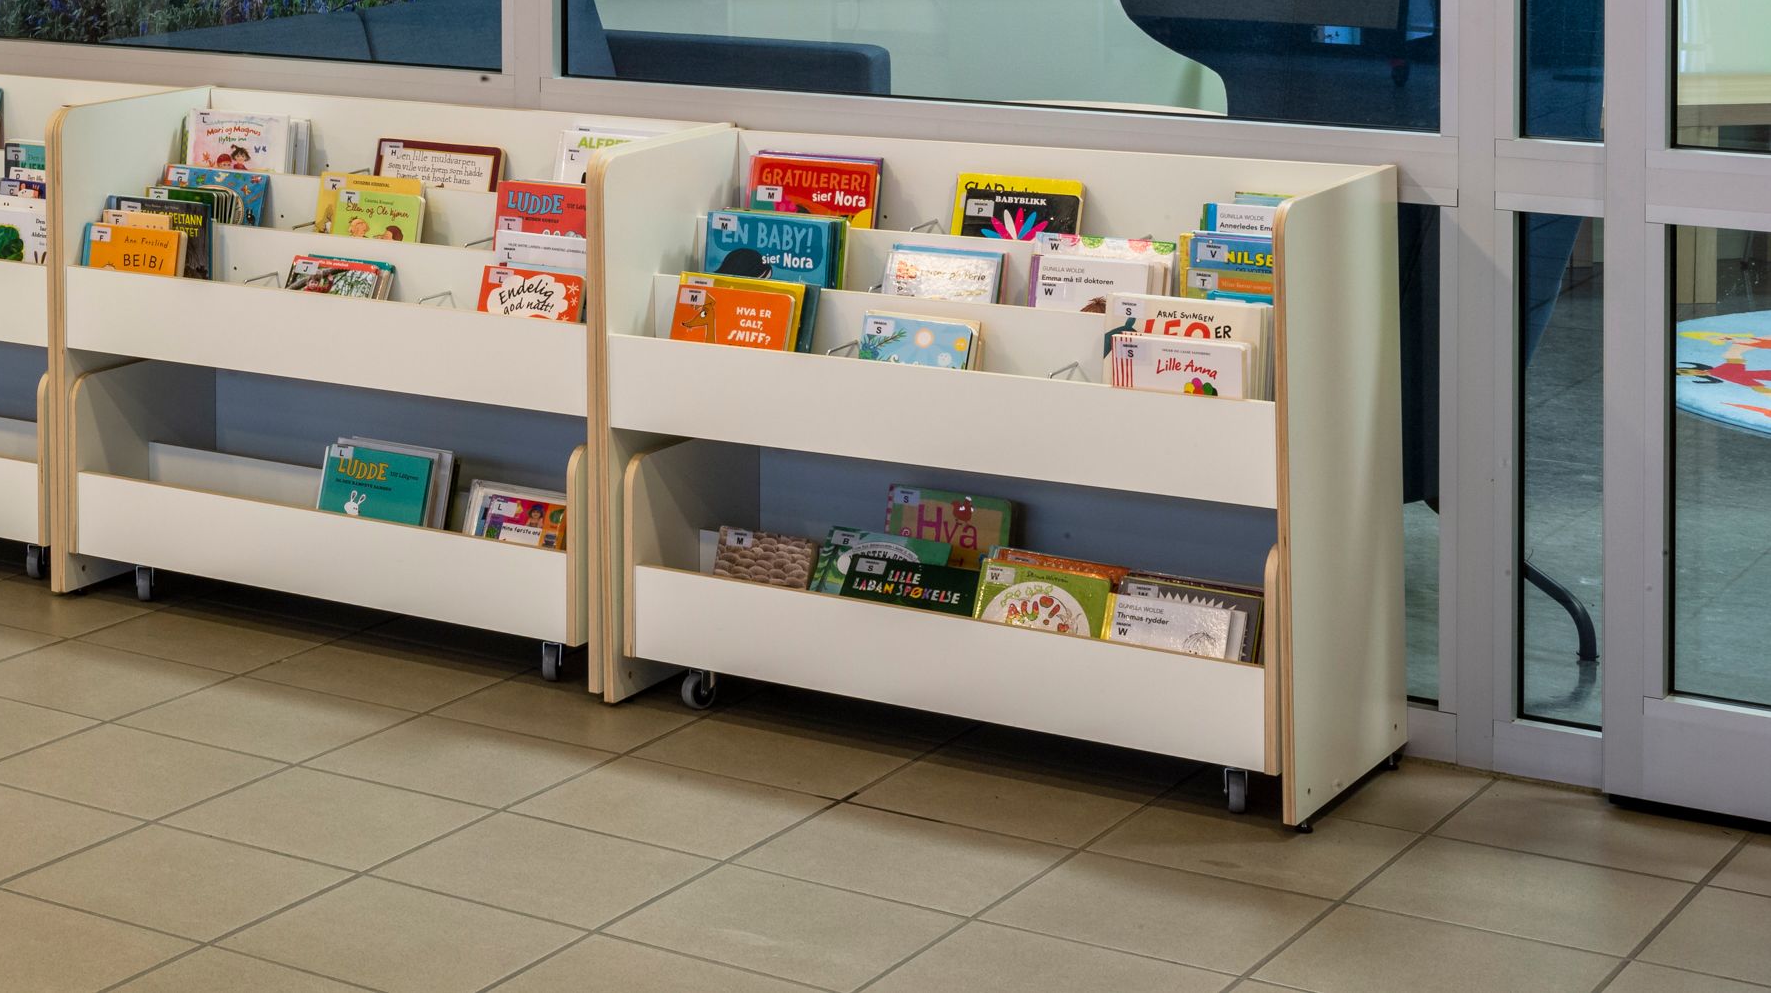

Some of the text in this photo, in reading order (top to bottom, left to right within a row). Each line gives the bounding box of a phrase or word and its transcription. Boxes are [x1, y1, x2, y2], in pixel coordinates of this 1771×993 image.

[233, 126, 261, 137] Magnus
[412, 150, 428, 162] lille
[431, 153, 477, 169] muldvarpen
[762, 168, 867, 192] GRATULERER!
[507, 190, 565, 215] LUDDE
[768, 192, 775, 200] M
[812, 191, 867, 207] sier Nora
[995, 195, 1047, 206] BABYBLIKK
[1219, 222, 1258, 231] Annerledes
[721, 222, 814, 254] EN BABY!
[1050, 243, 1060, 251] W
[1210, 250, 1217, 258] V
[123, 253, 164, 271] BEIBI
[762, 253, 814, 269] sier Nora
[1200, 278, 1207, 287] T
[498, 278, 555, 305] Endelig
[690, 294, 698, 302] M
[1044, 287, 1054, 296] W
[503, 298, 525, 315] god
[736, 306, 772, 318] HVA ER
[1125, 308, 1132, 316] S
[1156, 310, 1215, 323] ARNE SVINGEN
[739, 319, 763, 331] GALT,
[875, 326, 882, 334] S
[727, 330, 772, 345] SNIFF?
[1214, 325, 1232, 339] ER
[1127, 349, 1134, 358] S
[1156, 357, 1218, 380] Lille Anna
[338, 457, 388, 481] LUDDE
[903, 495, 910, 504] S
[917, 504, 978, 550] Hva
[736, 535, 744, 545] M
[887, 569, 922, 585] LILLE
[852, 577, 961, 605] LABAN SPØKELSE
[1117, 611, 1170, 625] Thomas rydder
[1118, 627, 1128, 636] W
